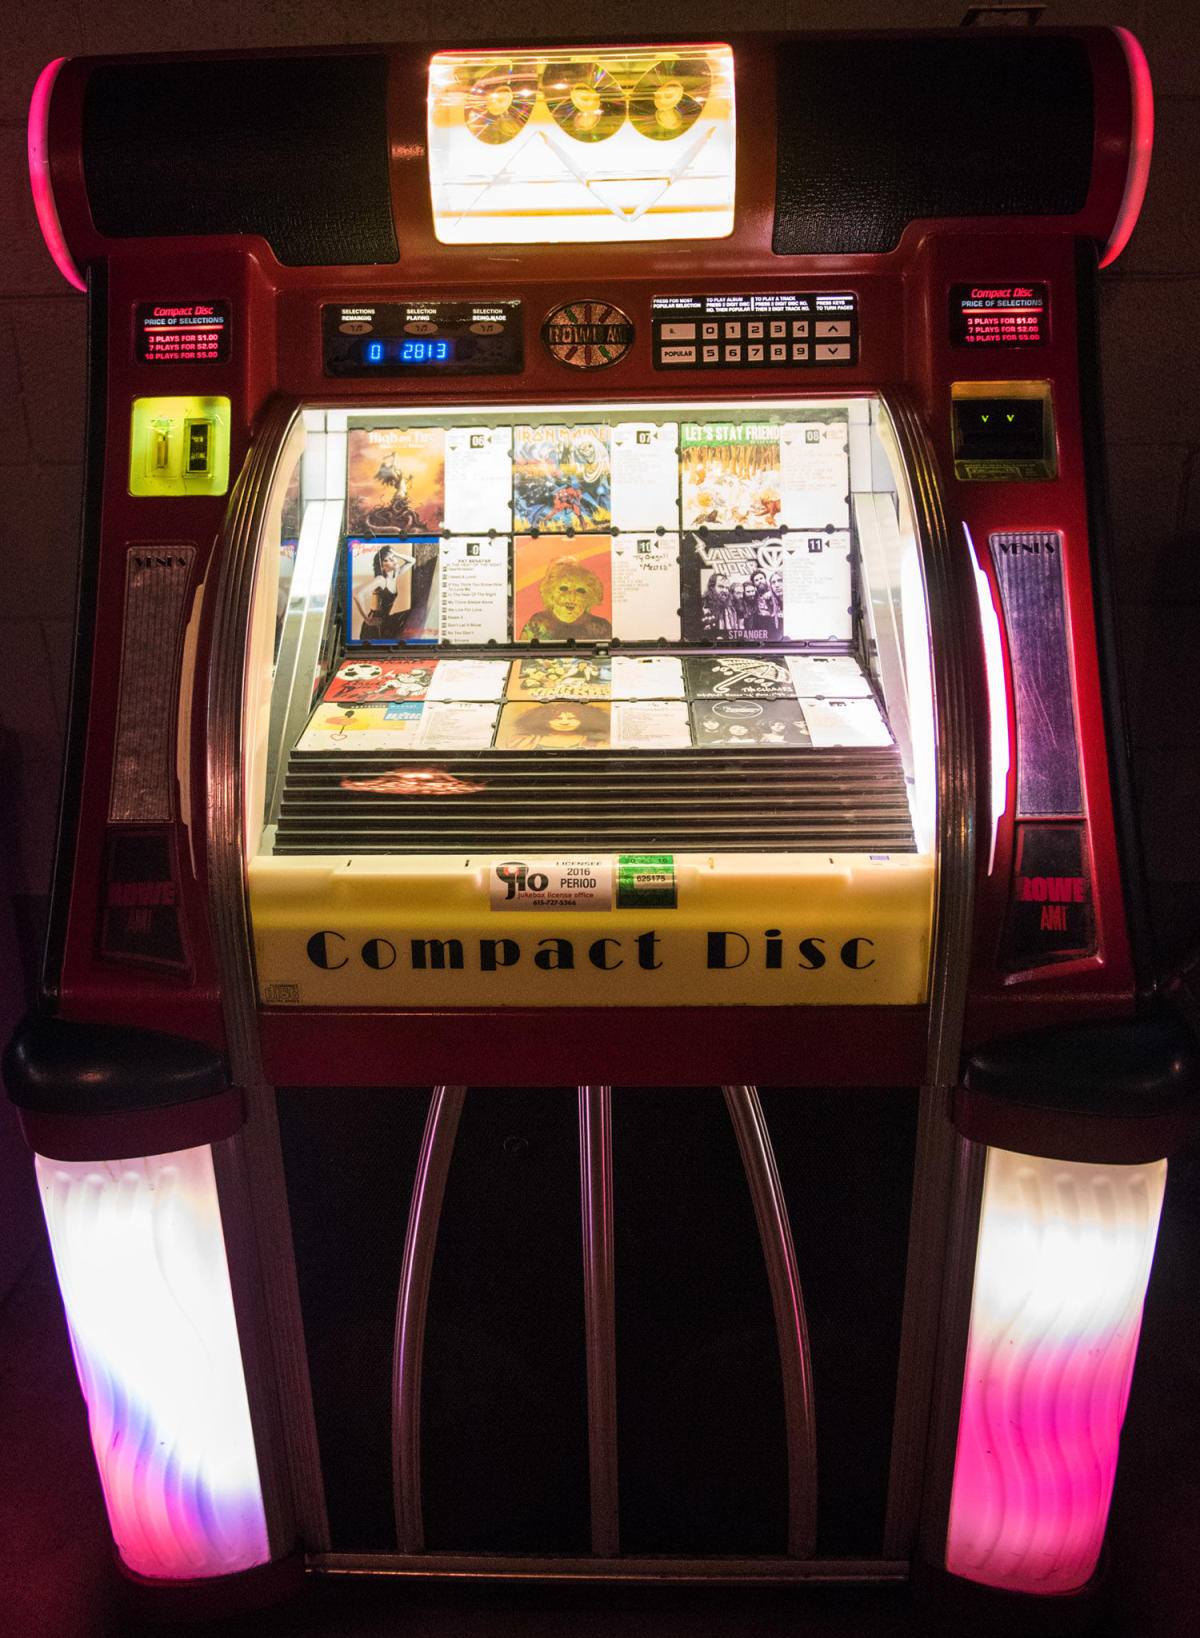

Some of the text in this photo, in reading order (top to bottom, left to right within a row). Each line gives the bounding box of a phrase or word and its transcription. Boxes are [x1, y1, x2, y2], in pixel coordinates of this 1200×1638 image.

[971, 288, 1033, 299] Compact Disc
[997, 299, 1043, 307] SELECTIONS
[153, 306, 214, 317] Compact Disc
[706, 326, 714, 334] 0
[729, 326, 735, 334] 1
[751, 326, 760, 334] 2
[774, 325, 782, 333] 3
[371, 343, 446, 360] 0 2813
[517, 430, 554, 443] IRON
[685, 426, 714, 441] LET'S
[715, 426, 742, 440] STAY
[809, 540, 821, 550] 11
[728, 630, 768, 640] STRANGER
[567, 868, 590, 876] 2016
[560, 878, 597, 888] PERIOD
[306, 929, 876, 971] Compact Disc
